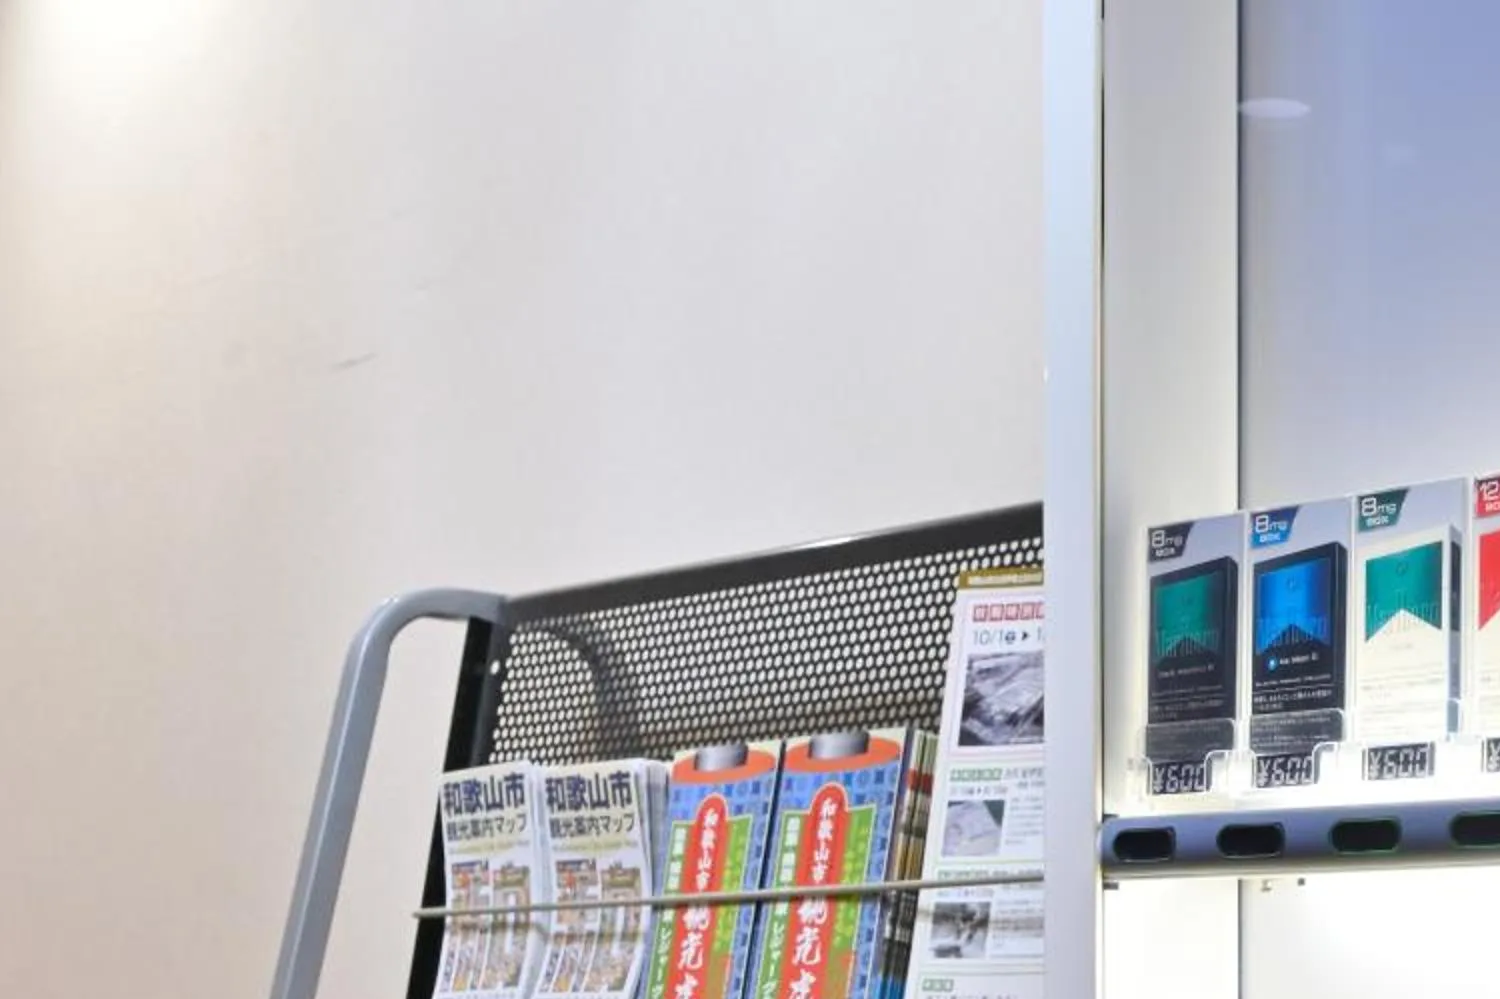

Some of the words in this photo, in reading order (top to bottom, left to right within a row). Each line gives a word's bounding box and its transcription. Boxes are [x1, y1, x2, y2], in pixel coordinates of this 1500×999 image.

[443, 771, 526, 816] 和歌山市
[544, 770, 634, 814] 和歌山市
[446, 812, 527, 842] 観光案内マップ
